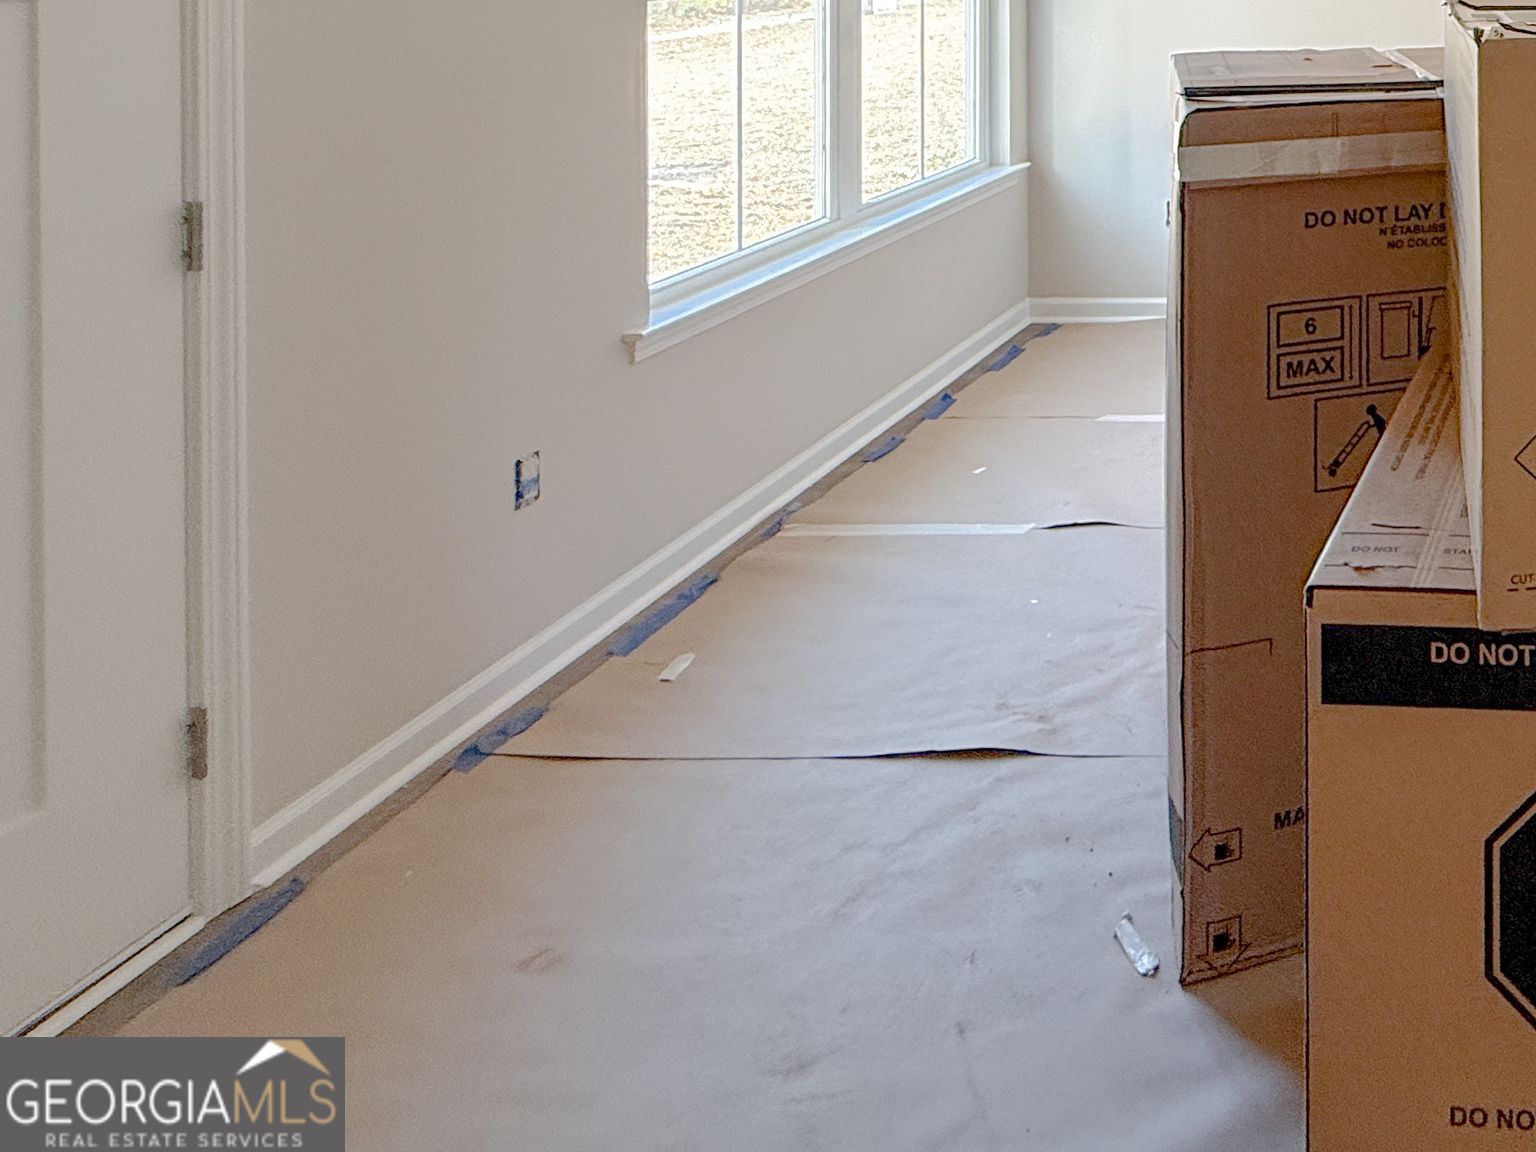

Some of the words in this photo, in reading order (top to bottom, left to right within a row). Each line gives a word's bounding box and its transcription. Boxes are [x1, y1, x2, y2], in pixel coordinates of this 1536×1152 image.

[1304, 210, 1336, 229] DO
[1343, 205, 1388, 225] NOT
[1394, 202, 1433, 222] LAY
[1387, 239, 1404, 249] NO
[1304, 316, 1317, 335] 6
[1285, 354, 1337, 378] MAX
[1510, 572, 1535, 586] CUT
[1430, 641, 1470, 666] DO
[1479, 642, 1536, 666] NOT
[1274, 805, 1305, 830] MA
[1449, 1106, 1489, 1128] DO
